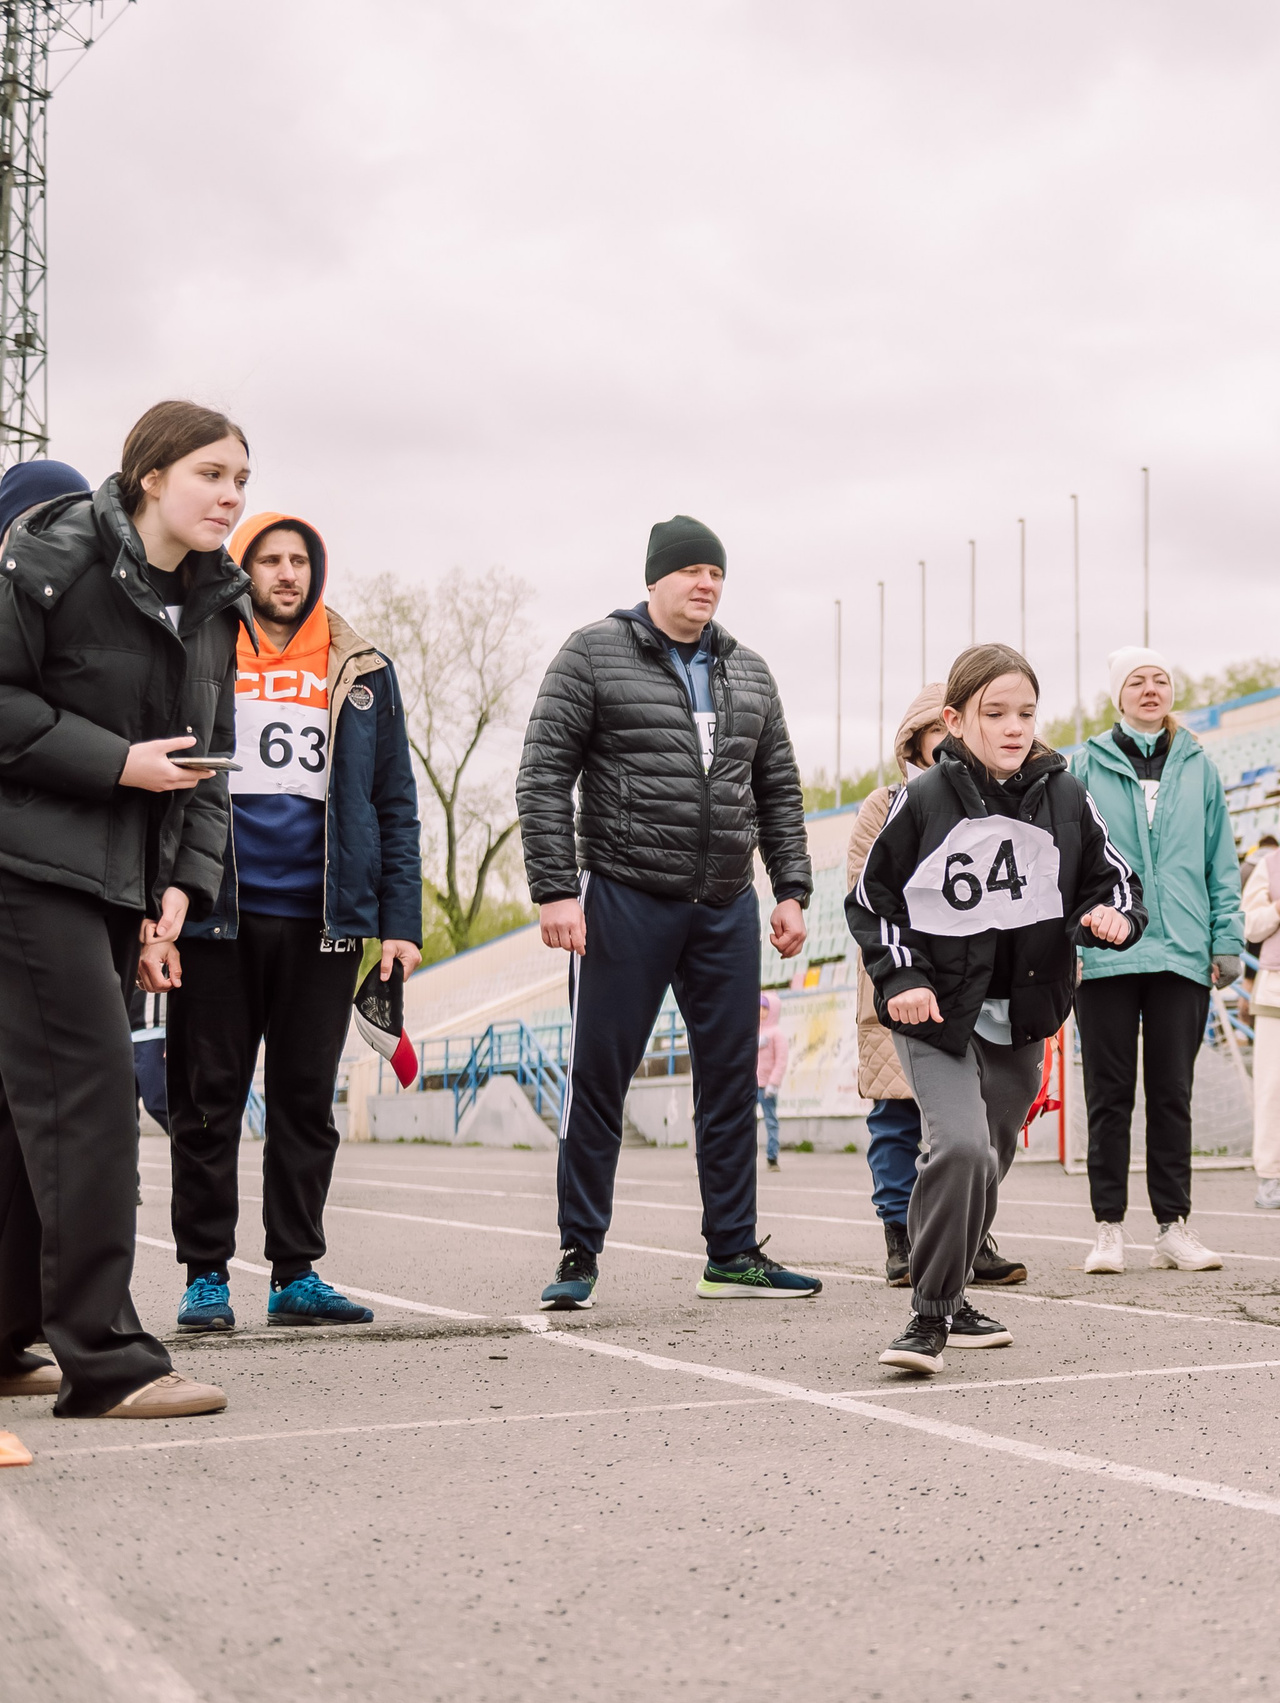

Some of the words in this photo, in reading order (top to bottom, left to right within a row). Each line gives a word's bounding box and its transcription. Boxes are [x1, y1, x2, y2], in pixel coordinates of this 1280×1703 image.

[235, 670, 328, 700] CCM
[259, 721, 326, 773] 63
[941, 838, 1028, 911] 64
